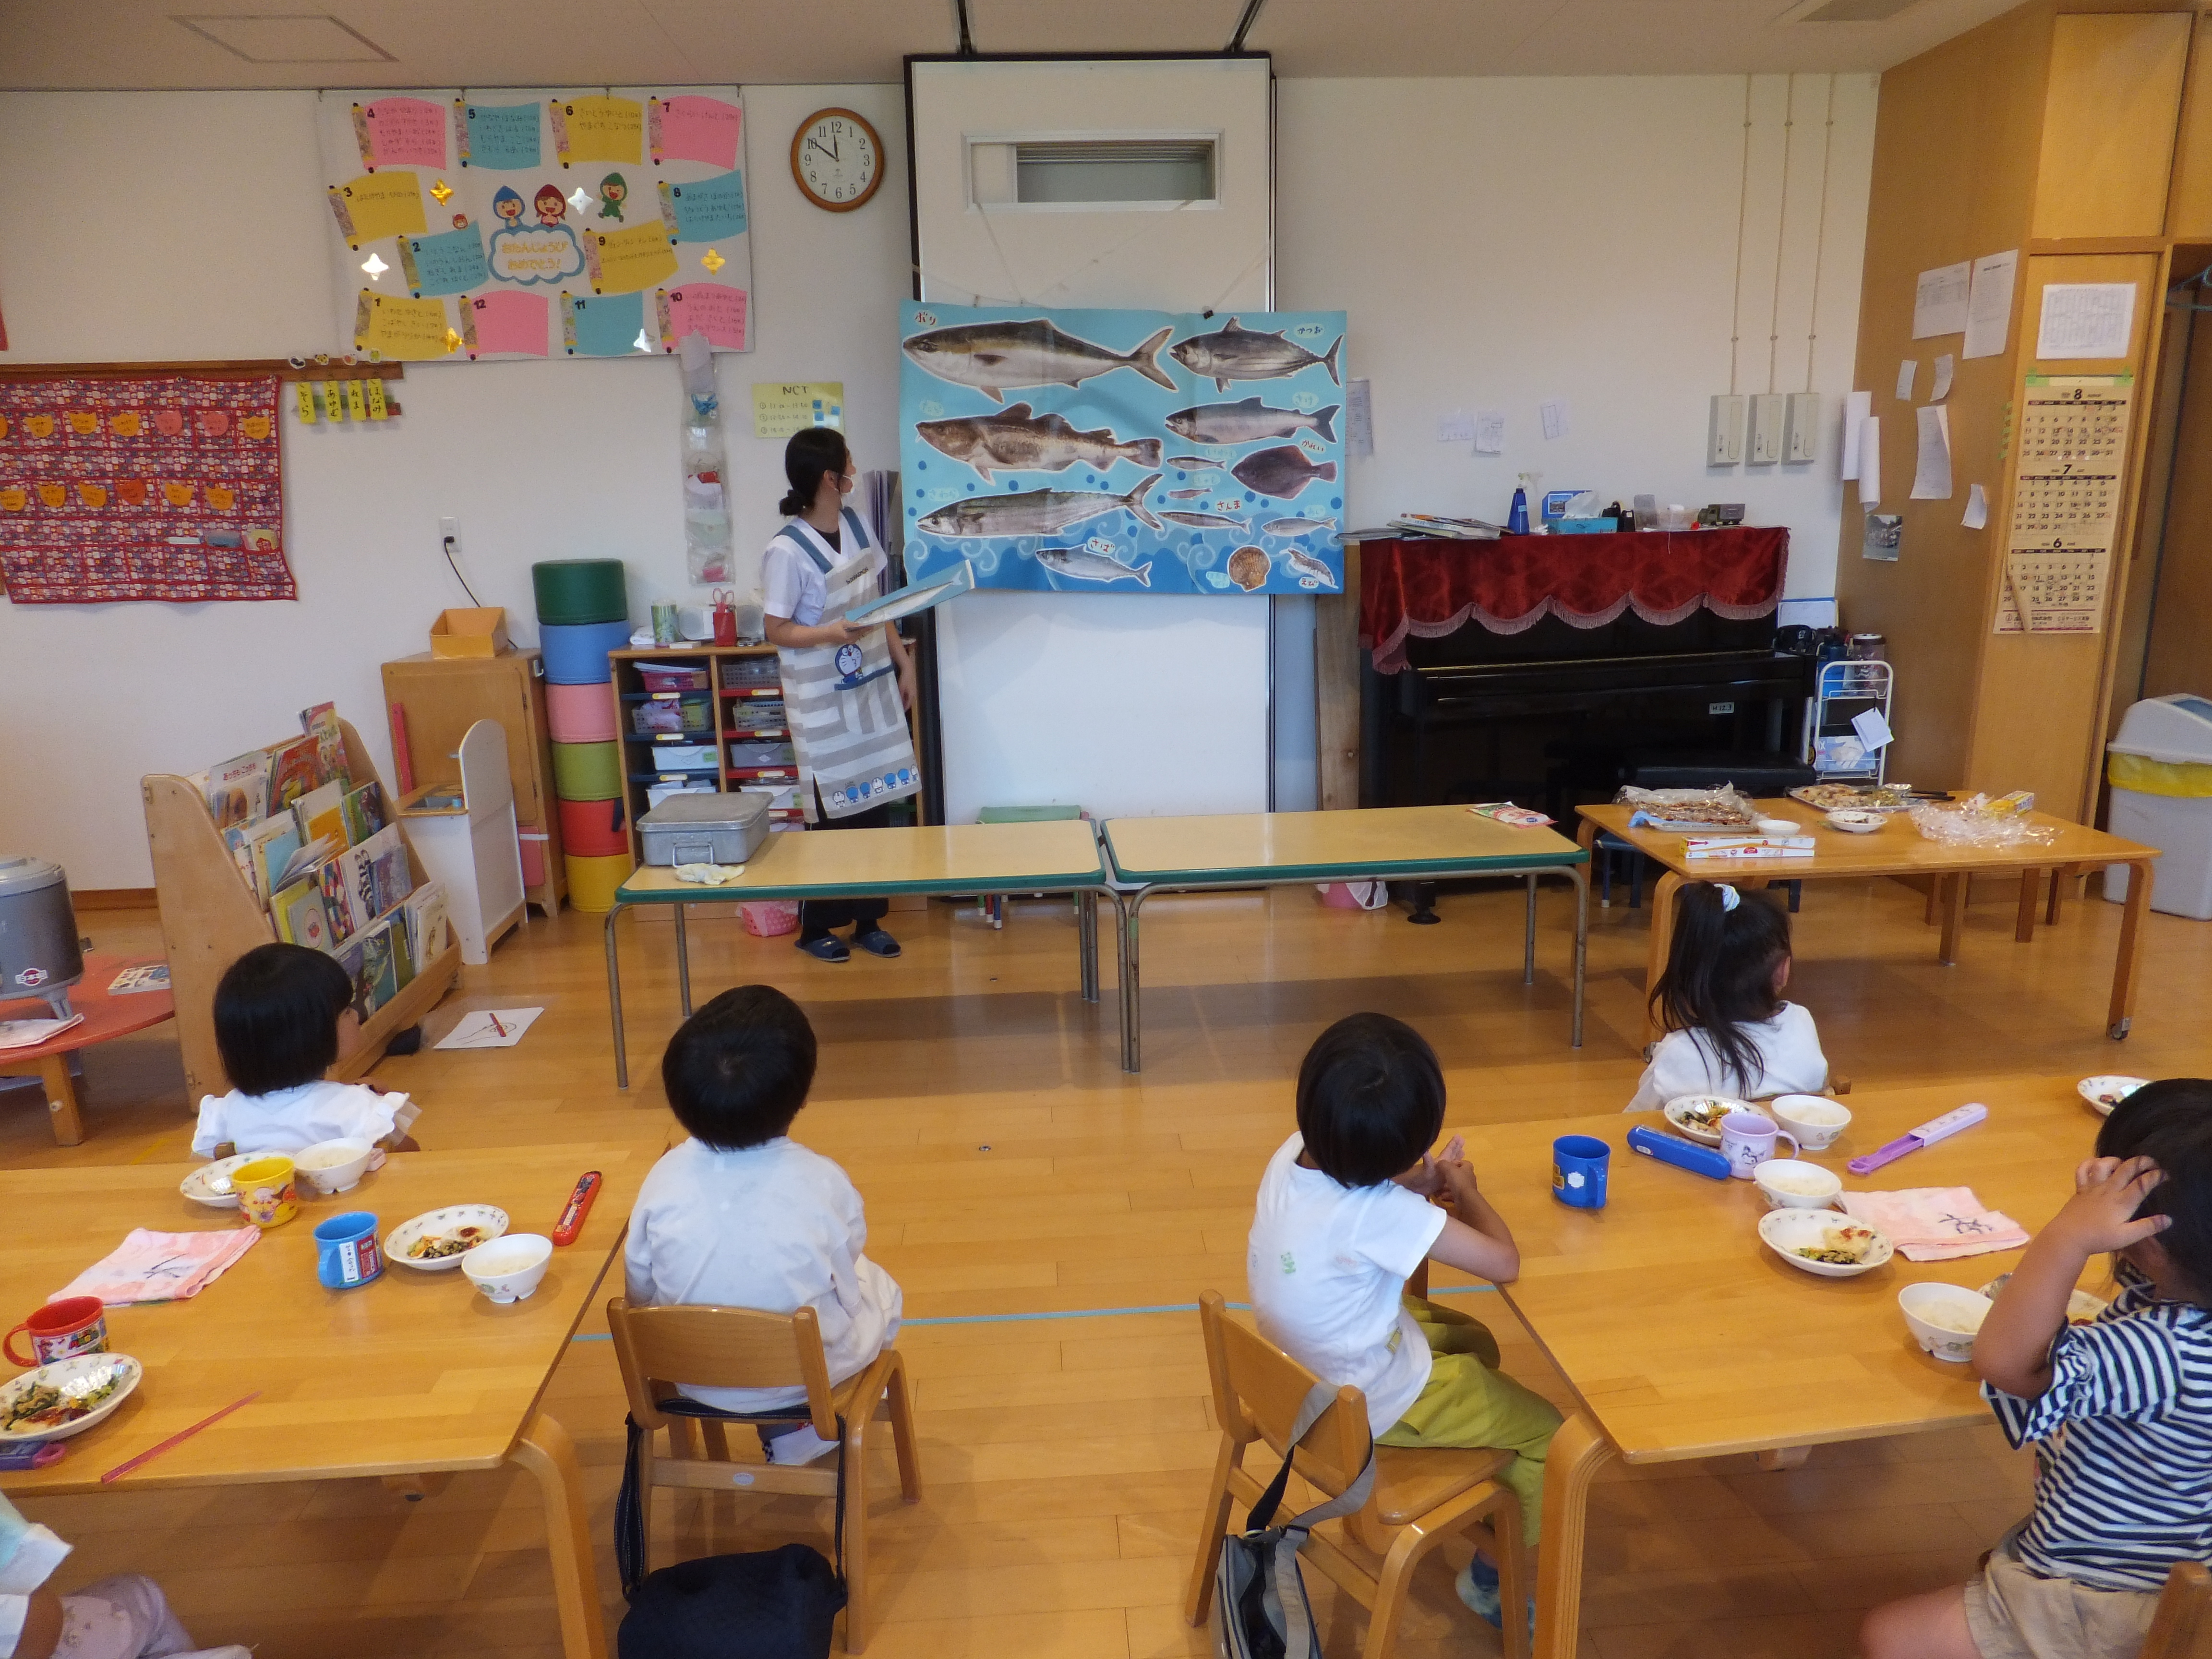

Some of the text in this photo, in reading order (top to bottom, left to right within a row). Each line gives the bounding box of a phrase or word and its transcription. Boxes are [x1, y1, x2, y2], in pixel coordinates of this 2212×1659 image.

[566, 106, 573, 116] 6
[663, 102, 671, 112] 7
[367, 108, 374, 119] 4
[469, 108, 475, 119] 5
[818, 126, 826, 137] 11
[831, 121, 842, 133] 12
[850, 126, 853, 137] 1
[859, 138, 866, 149] 2
[805, 154, 811, 166] 9
[864, 154, 870, 166] 3
[810, 171, 817, 182] 8
[860, 171, 866, 182] 4
[344, 187, 352, 197] 3
[673, 187, 681, 197] 8
[821, 183, 828, 194] 7
[836, 187, 842, 199] 6
[850, 183, 856, 195] 5
[599, 236, 606, 246] 9
[412, 242, 421, 252] 2
[670, 291, 683, 302] 10
[375, 298, 381, 307] 1
[473, 299, 486, 310] 12
[575, 299, 586, 310] 11
[1297, 326, 1323, 335] かつお
[782, 385, 807, 396] NCT
[2074, 389, 2082, 399] 8
[2063, 464, 2072, 474] 7
[1216, 500, 1241, 511] さんま
[1090, 538, 1116, 552] さば
[2053, 538, 2062, 548] 6
[1301, 577, 1318, 587] えび
